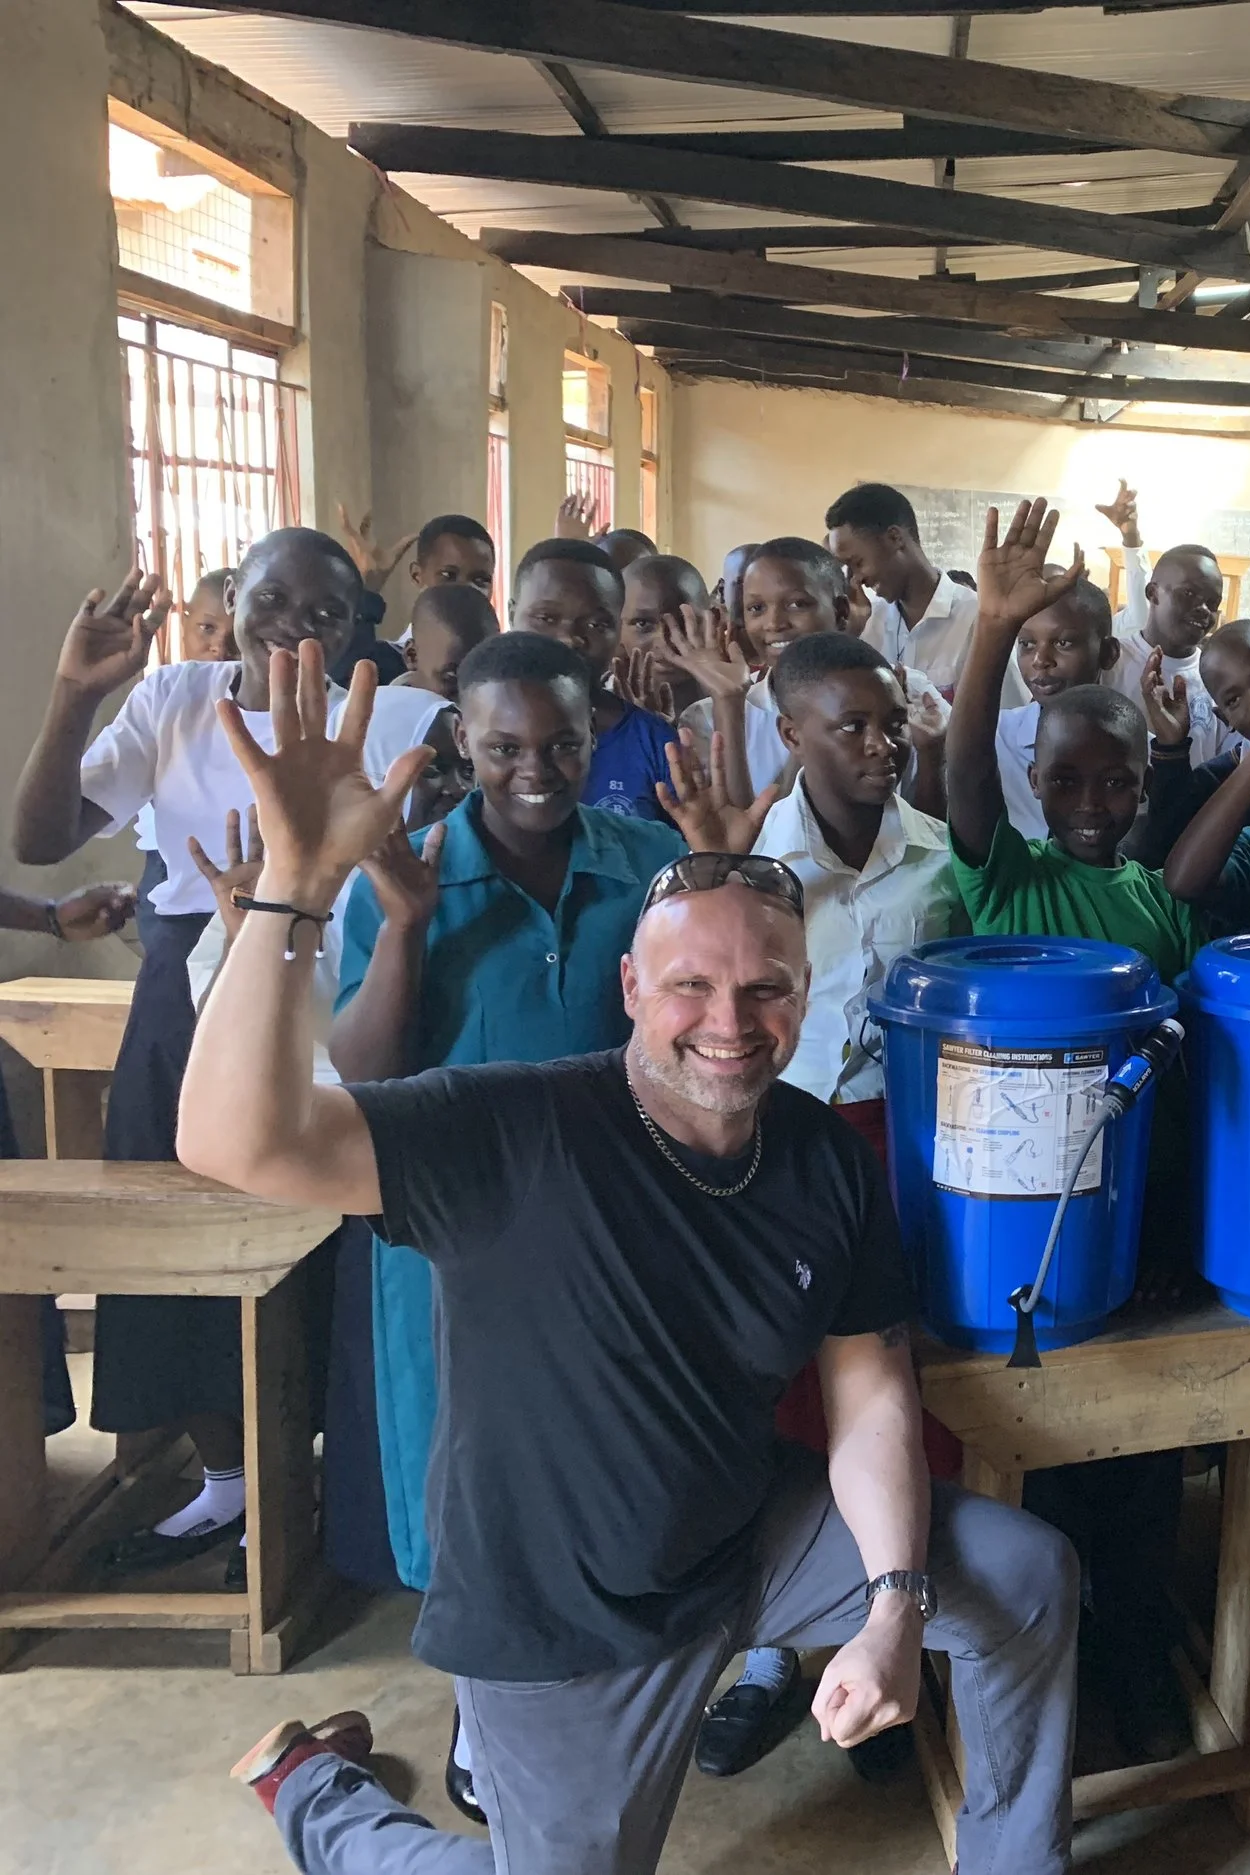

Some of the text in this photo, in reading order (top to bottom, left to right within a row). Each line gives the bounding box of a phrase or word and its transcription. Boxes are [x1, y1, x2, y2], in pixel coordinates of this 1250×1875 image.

[609, 780, 624, 791] 81
[942, 1043, 964, 1054] SAWYER
[964, 1047, 983, 1057] FILTER
[1011, 1053, 1053, 1061] INSTRUCTIONS
[1074, 1053, 1101, 1061] SAWYER
